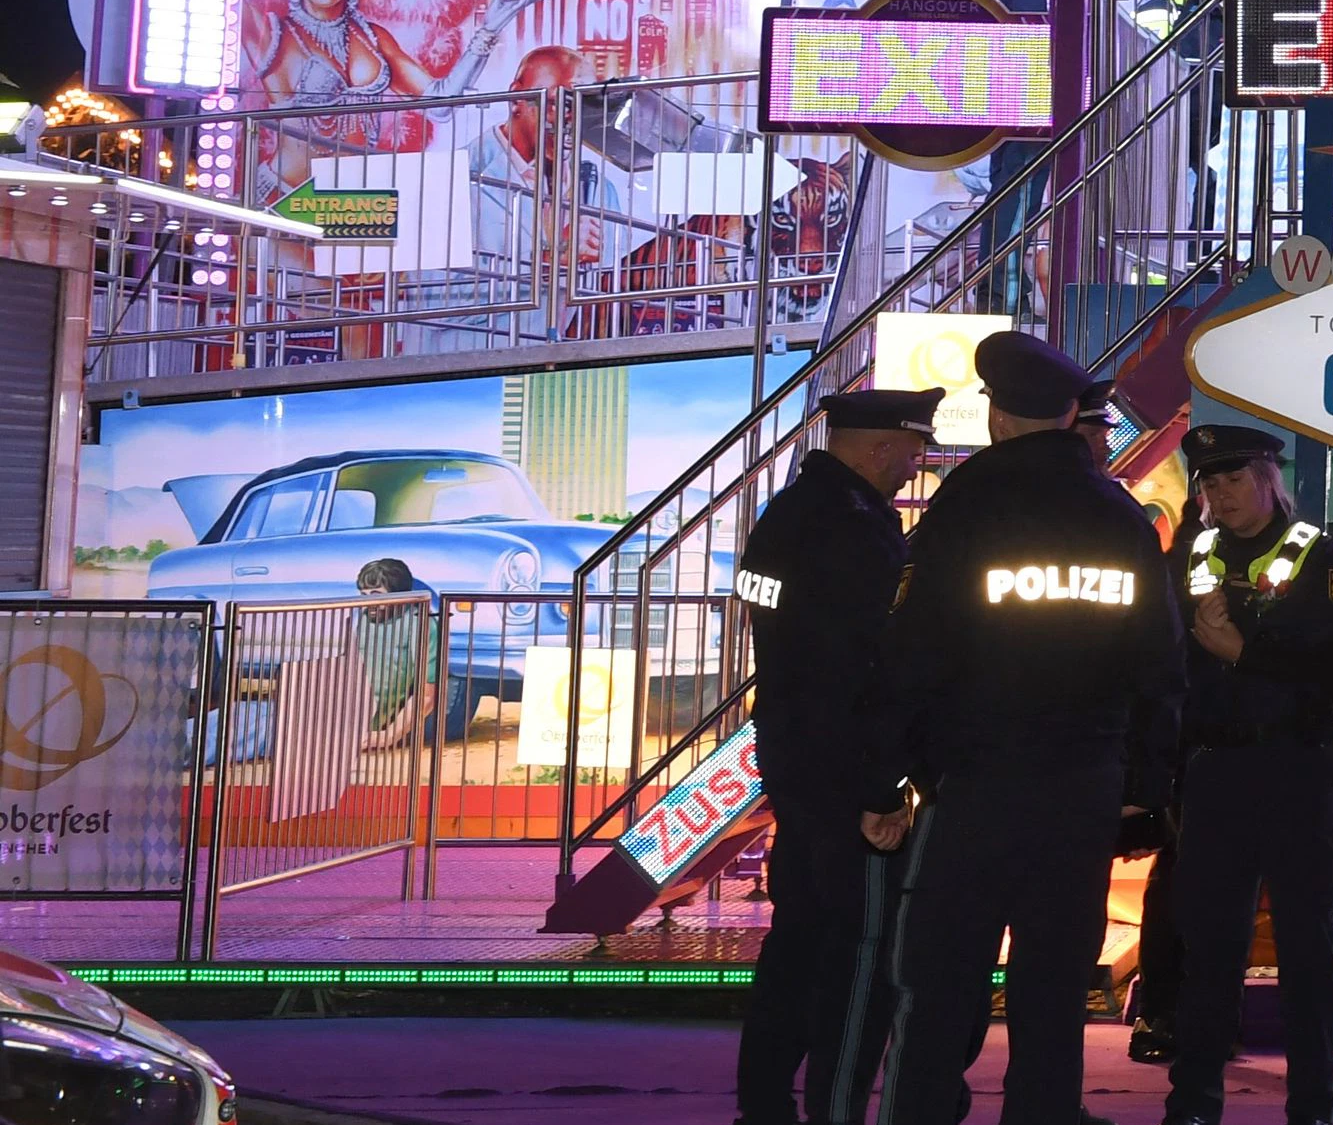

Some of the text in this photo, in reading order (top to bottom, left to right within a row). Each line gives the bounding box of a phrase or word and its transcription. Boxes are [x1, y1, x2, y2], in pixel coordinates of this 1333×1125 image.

[585, 0, 629, 42] NO
[889, 0, 980, 13] HANGOVER
[790, 32, 1051, 119] EXIT
[289, 195, 398, 212] ENTRANCE
[314, 212, 396, 226] EINGANG
[986, 565, 1135, 607] POLIZEI
